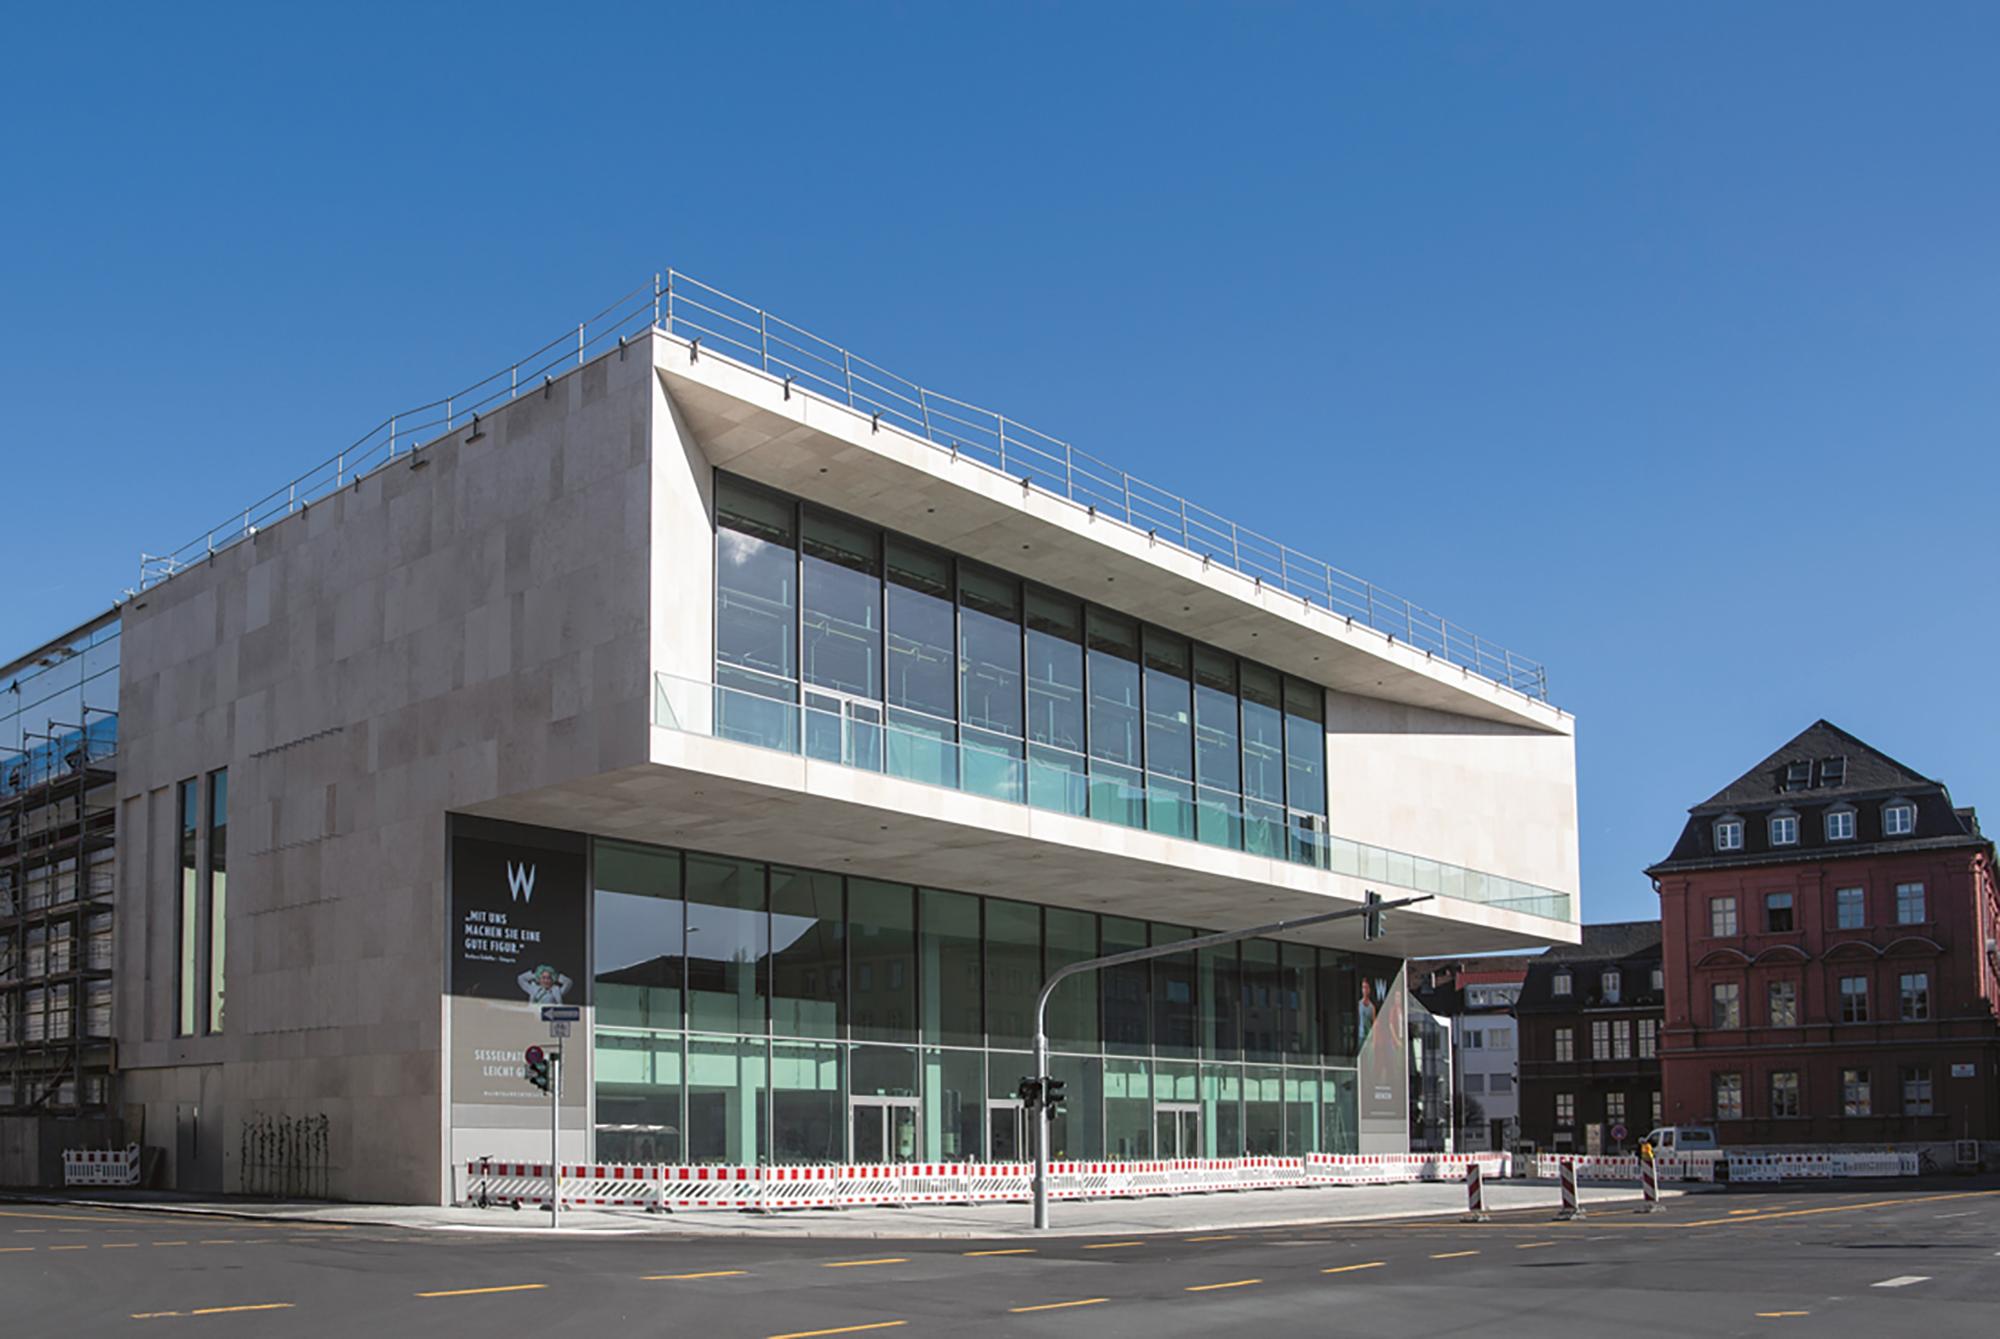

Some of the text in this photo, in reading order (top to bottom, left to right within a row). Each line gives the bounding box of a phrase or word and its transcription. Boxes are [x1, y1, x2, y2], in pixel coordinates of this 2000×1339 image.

[507, 860, 536, 903] W
[488, 912, 507, 925] UNS
[465, 924, 541, 942] MACHEN SIE EINE
[465, 937, 488, 951] GUTE
[483, 1065, 514, 1077] LEICHT
